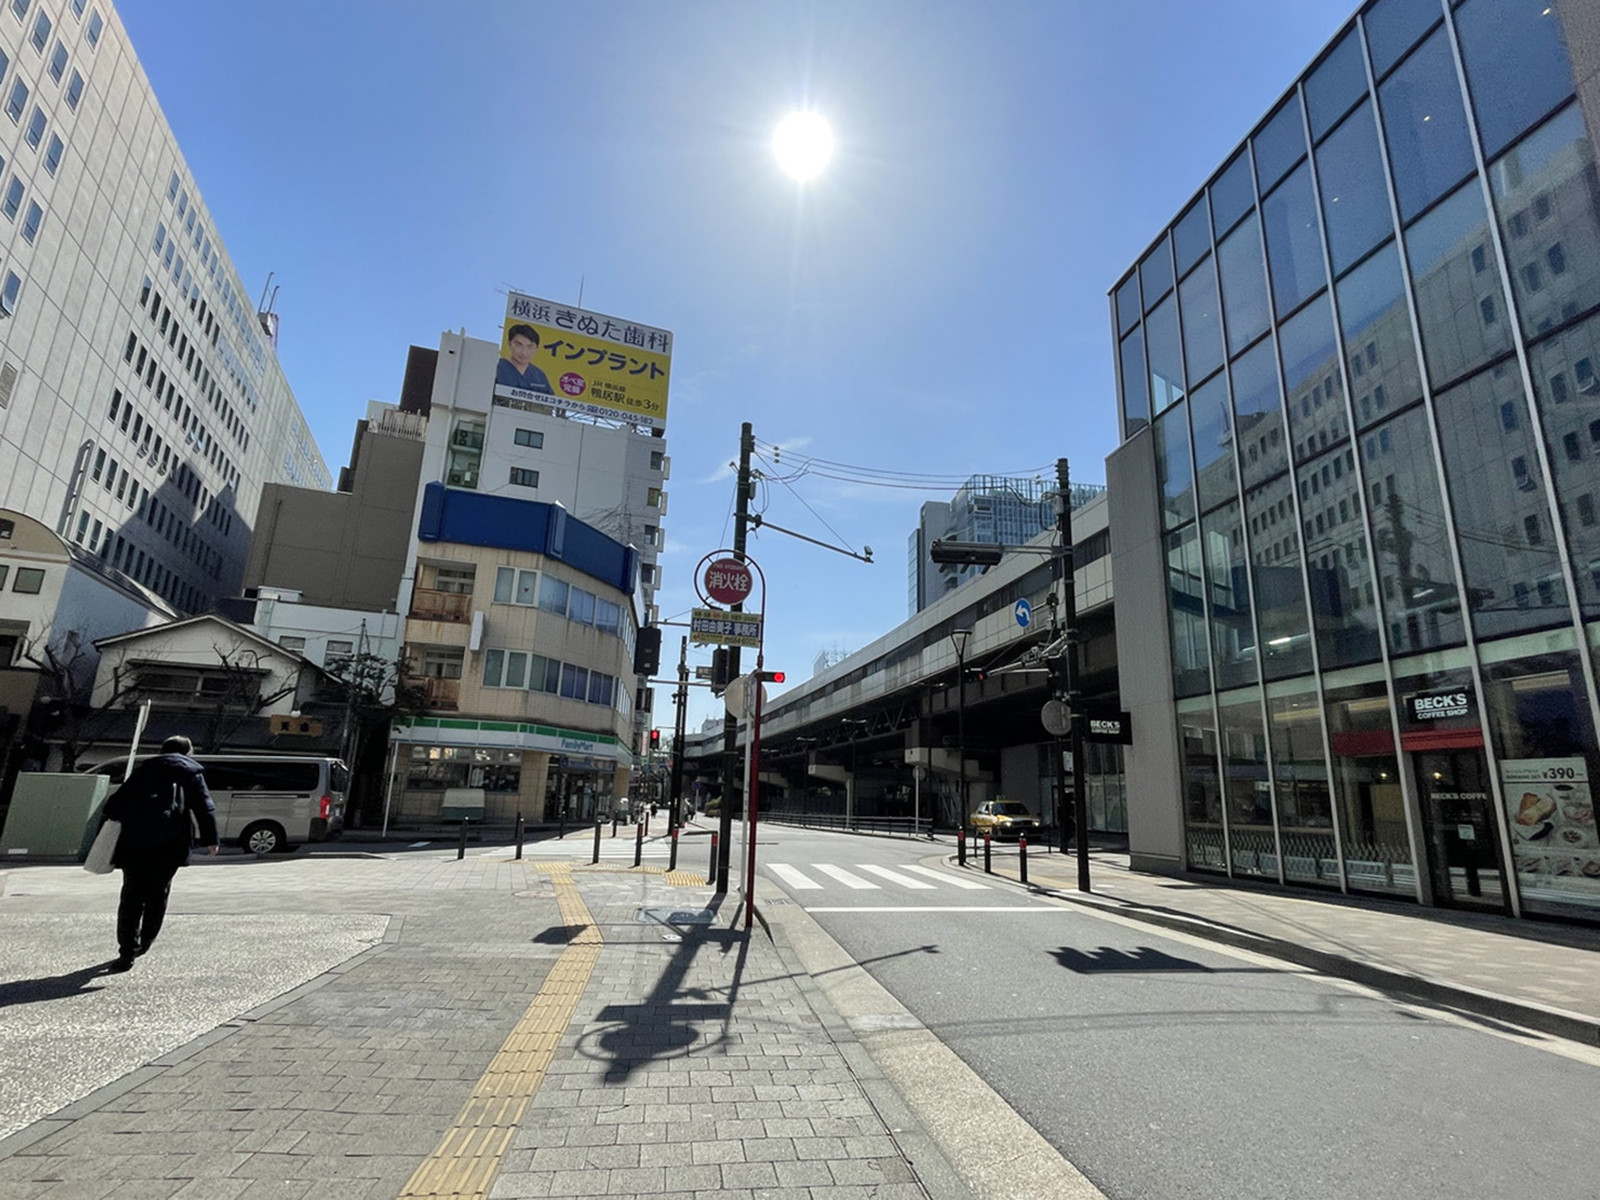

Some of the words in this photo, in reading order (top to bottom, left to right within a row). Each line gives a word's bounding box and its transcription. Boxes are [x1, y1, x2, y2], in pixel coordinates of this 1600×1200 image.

[543, 340, 665, 379] インプラント
[510, 389, 585, 411] お問合せはコチラから
[708, 571, 748, 592] 消火栓
[1414, 693, 1467, 710] BECK'S
[1417, 710, 1446, 720] COFFEE
[1446, 708, 1468, 717] SHOP
[1090, 720, 1120, 729] BECK'S
[561, 739, 594, 751] FamilyMart
